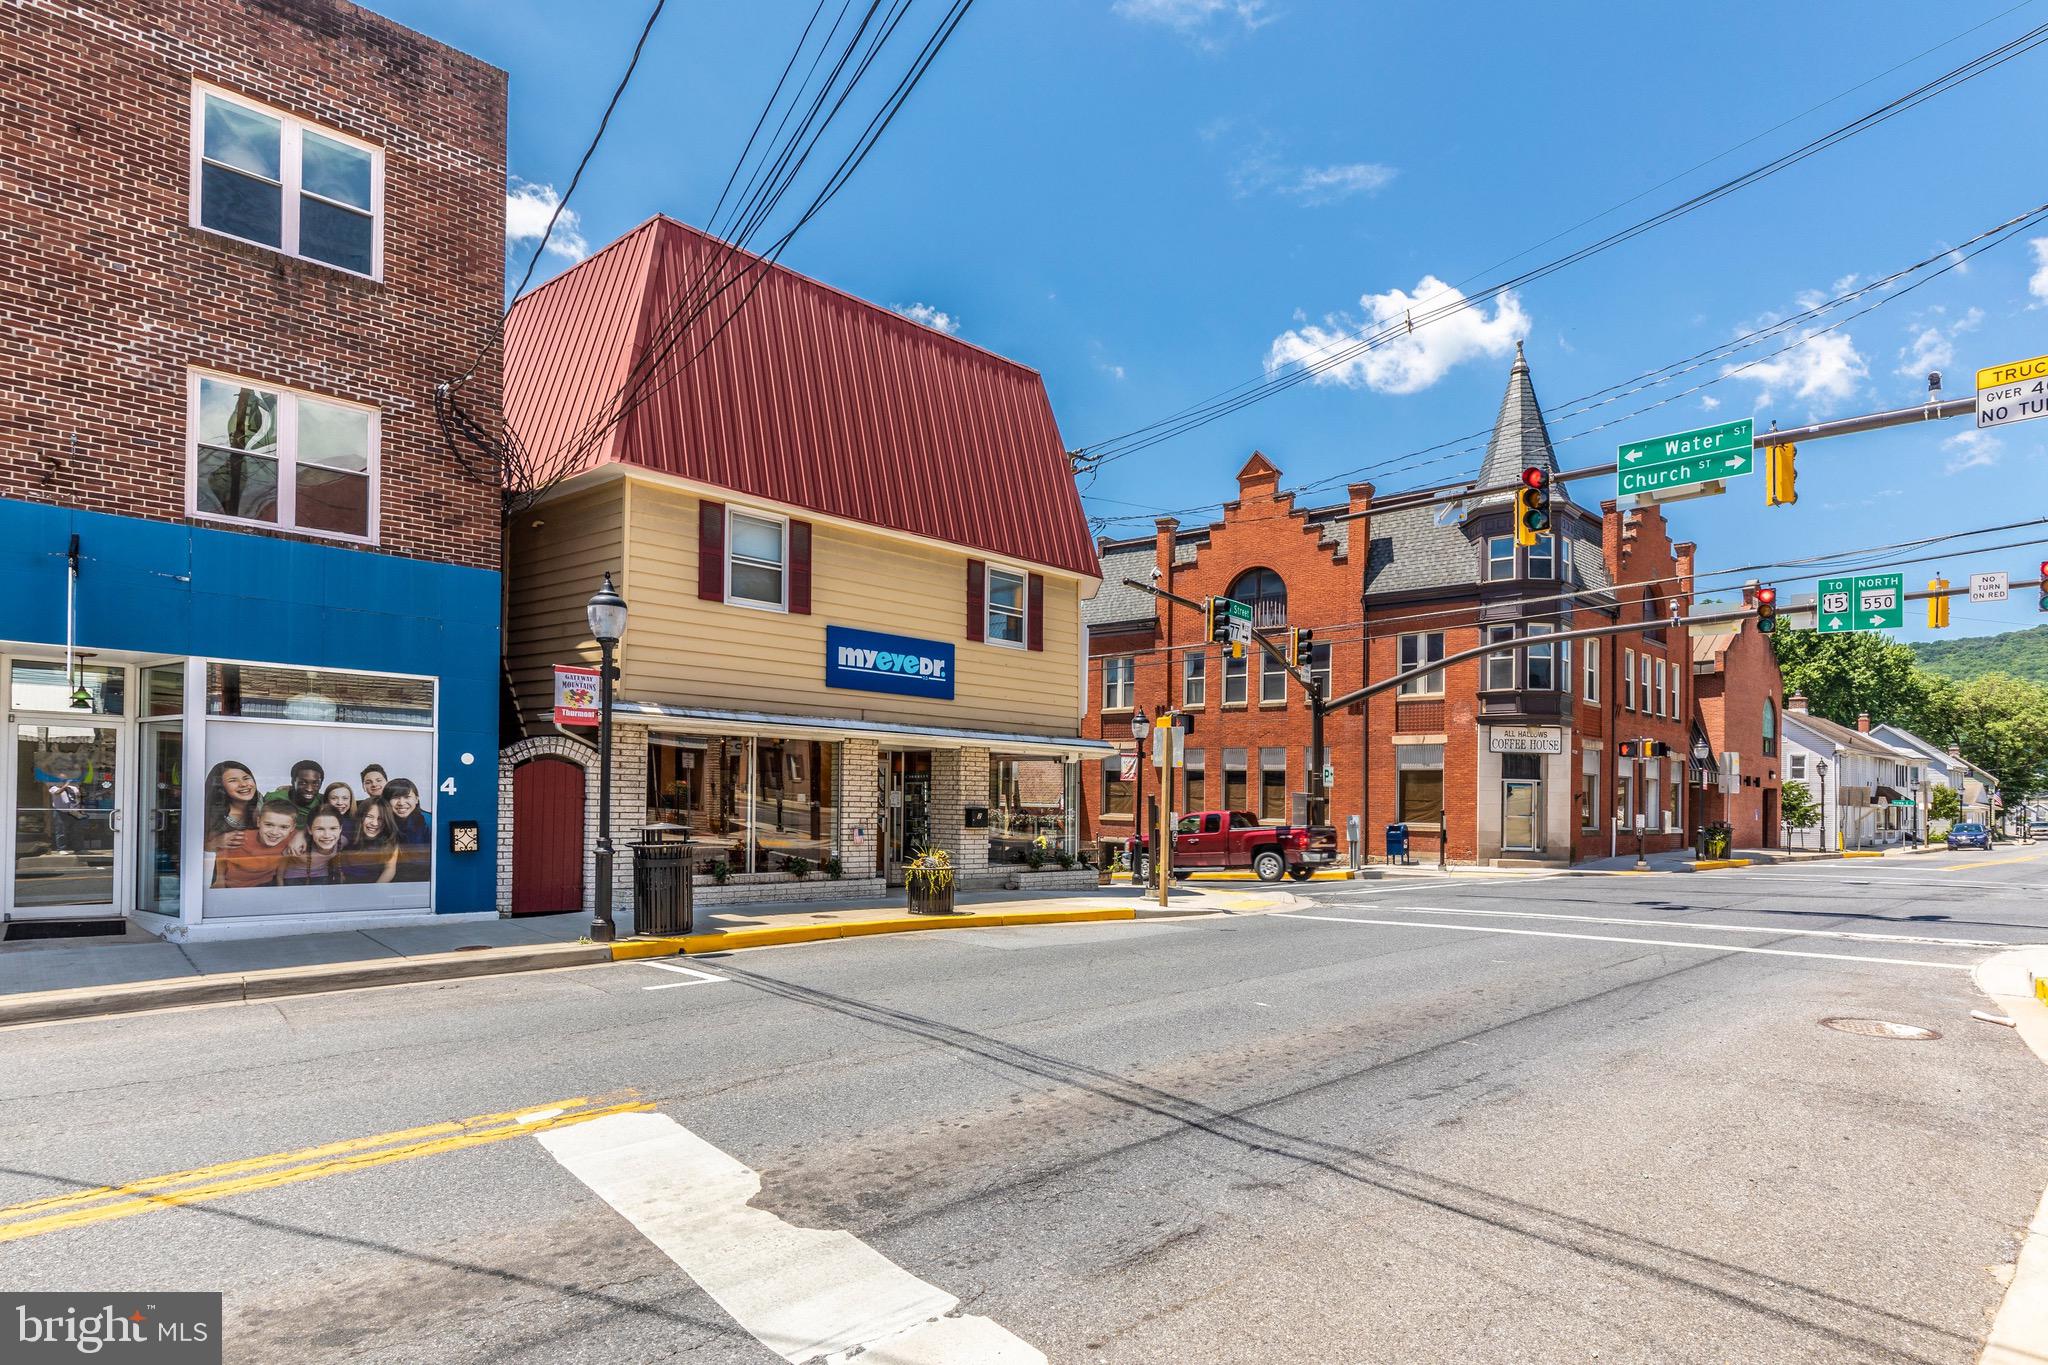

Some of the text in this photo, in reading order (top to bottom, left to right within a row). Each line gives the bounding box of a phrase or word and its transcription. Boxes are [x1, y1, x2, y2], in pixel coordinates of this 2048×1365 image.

[2031, 381, 2048, 394] 4
[1982, 398, 2048, 423] NO TU
[1665, 425, 1747, 456] Water ST
[1623, 459, 1711, 489] Church ST
[1828, 582, 1843, 590] TO
[1858, 577, 1899, 588] NORTH
[1978, 583, 2000, 591] TURN
[1827, 597, 1844, 609] 15
[1864, 596, 1893, 610] 550
[1233, 605, 1250, 618] Street
[1230, 625, 1240, 639] 77
[562, 681, 596, 691] MOUNTAINS
[1491, 738, 1559, 751] COFFEE HOUSE
[440, 777, 457, 796] 4
